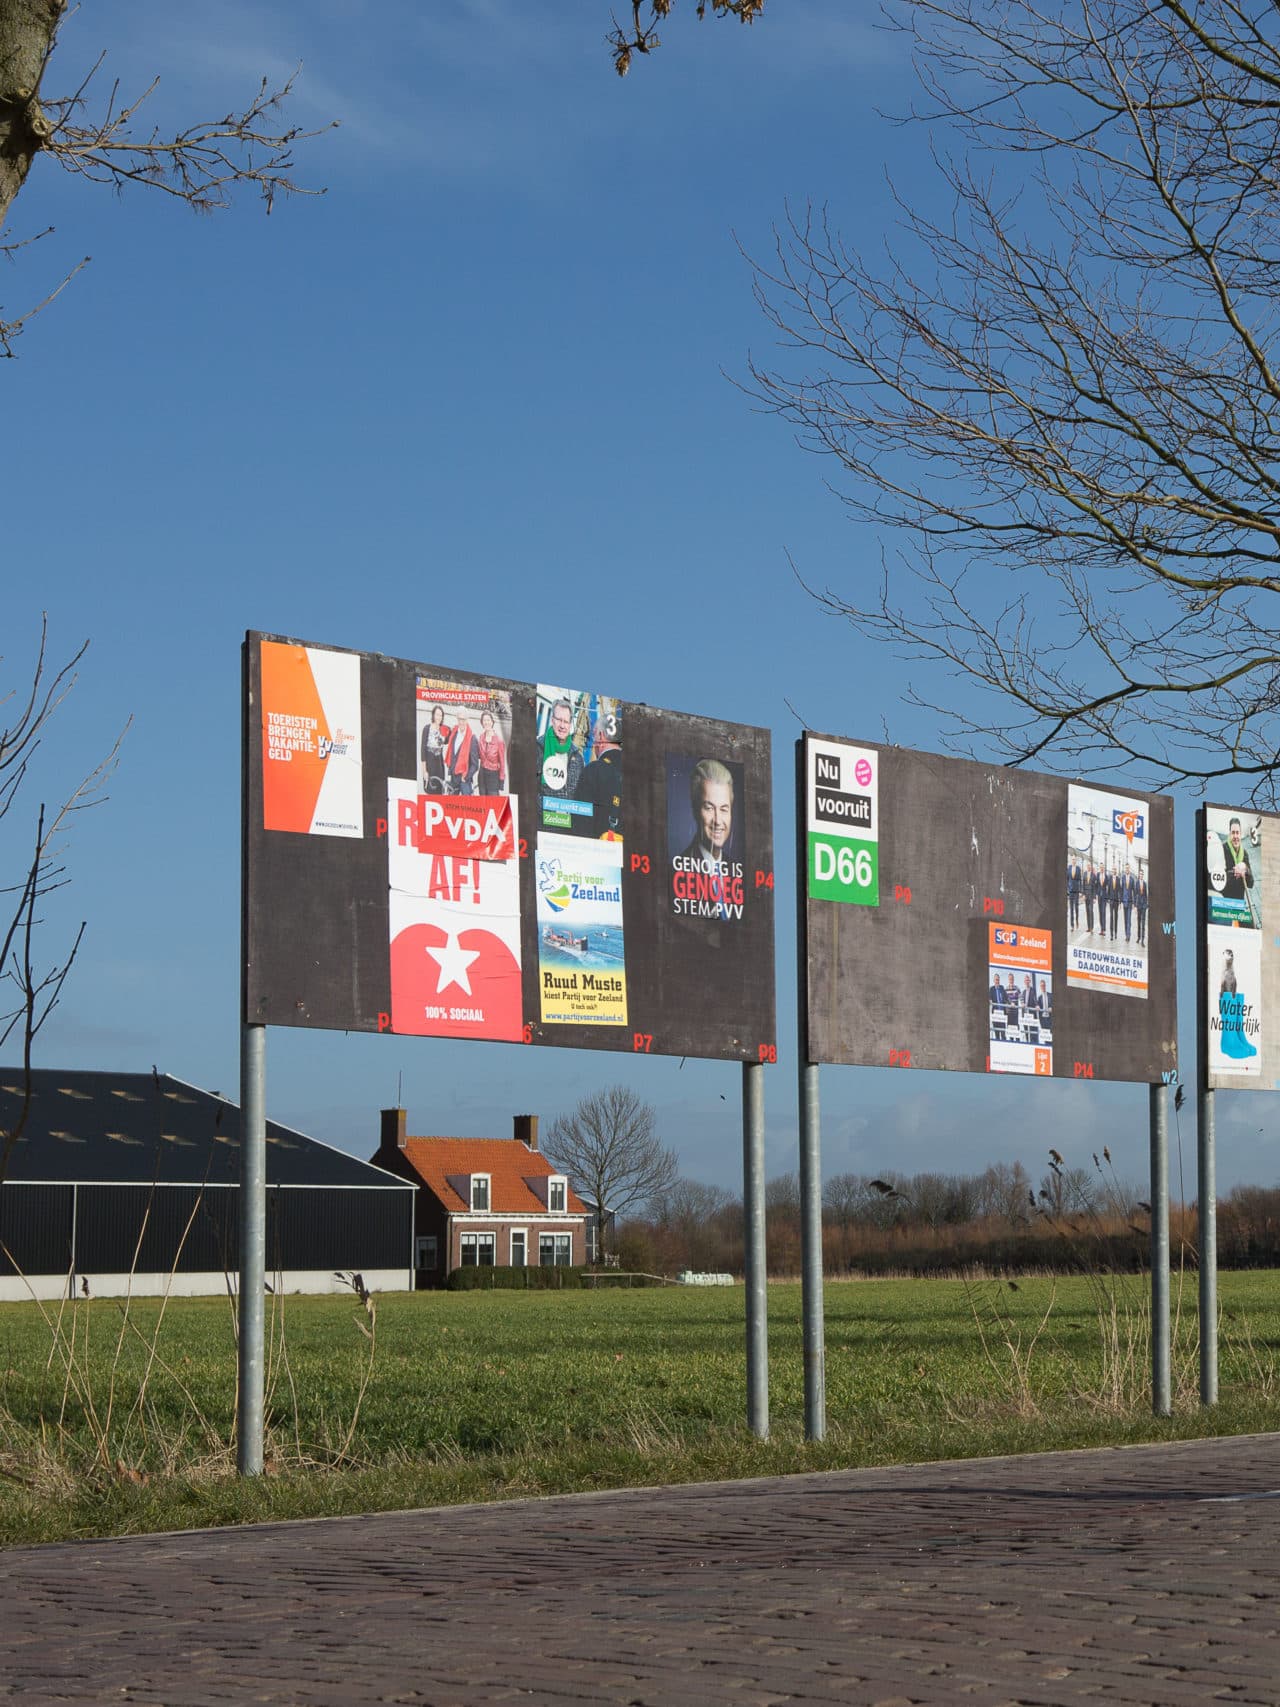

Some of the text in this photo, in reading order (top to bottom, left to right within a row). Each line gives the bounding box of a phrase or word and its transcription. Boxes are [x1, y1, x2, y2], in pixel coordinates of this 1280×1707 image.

[421, 691, 487, 701] PROVINCIALE STATEN
[267, 712, 318, 730] TOERISTEN
[606, 714, 617, 736] 3
[267, 724, 311, 740] BRENGEN
[268, 735, 317, 752] VAKANTIE-
[268, 748, 292, 762] GELD
[818, 758, 839, 781] Nu
[817, 796, 870, 820] vooruit
[544, 813, 570, 825] Zeeland
[1115, 814, 1142, 833] SGP
[1250, 827, 1258, 845] 3
[631, 853, 651, 874] P3
[672, 855, 743, 878] GENOEG IS
[815, 842, 873, 887] D66
[428, 855, 480, 904] AF!
[557, 870, 605, 885] Partij voor
[755, 870, 774, 890] P4
[1212, 873, 1225, 881] CDA
[571, 884, 621, 902] Zeeland
[673, 871, 744, 905] GENOEG
[895, 885, 912, 905] P9
[673, 898, 744, 920] STEM PVV
[984, 897, 1004, 915] P10
[996, 931, 1047, 949] SGP Zeeland
[1073, 948, 1143, 968] BETROUWBAAR EN
[1078, 960, 1138, 979] DAADKRACHTIG
[544, 972, 622, 991] Ruud Muste
[544, 991, 561, 1000] kiest
[562, 991, 581, 1002] Partij
[598, 993, 623, 1002] Zeeland
[425, 1006, 485, 1022] 100% SOCIAAL
[1219, 1000, 1253, 1017] Water
[1210, 1017, 1260, 1036] Natuurlijk
[633, 1032, 653, 1053] P7
[758, 1044, 777, 1063] P8
[889, 1049, 911, 1067] P12
[1040, 1061, 1046, 1072] 2
[1074, 1062, 1094, 1078] P14
